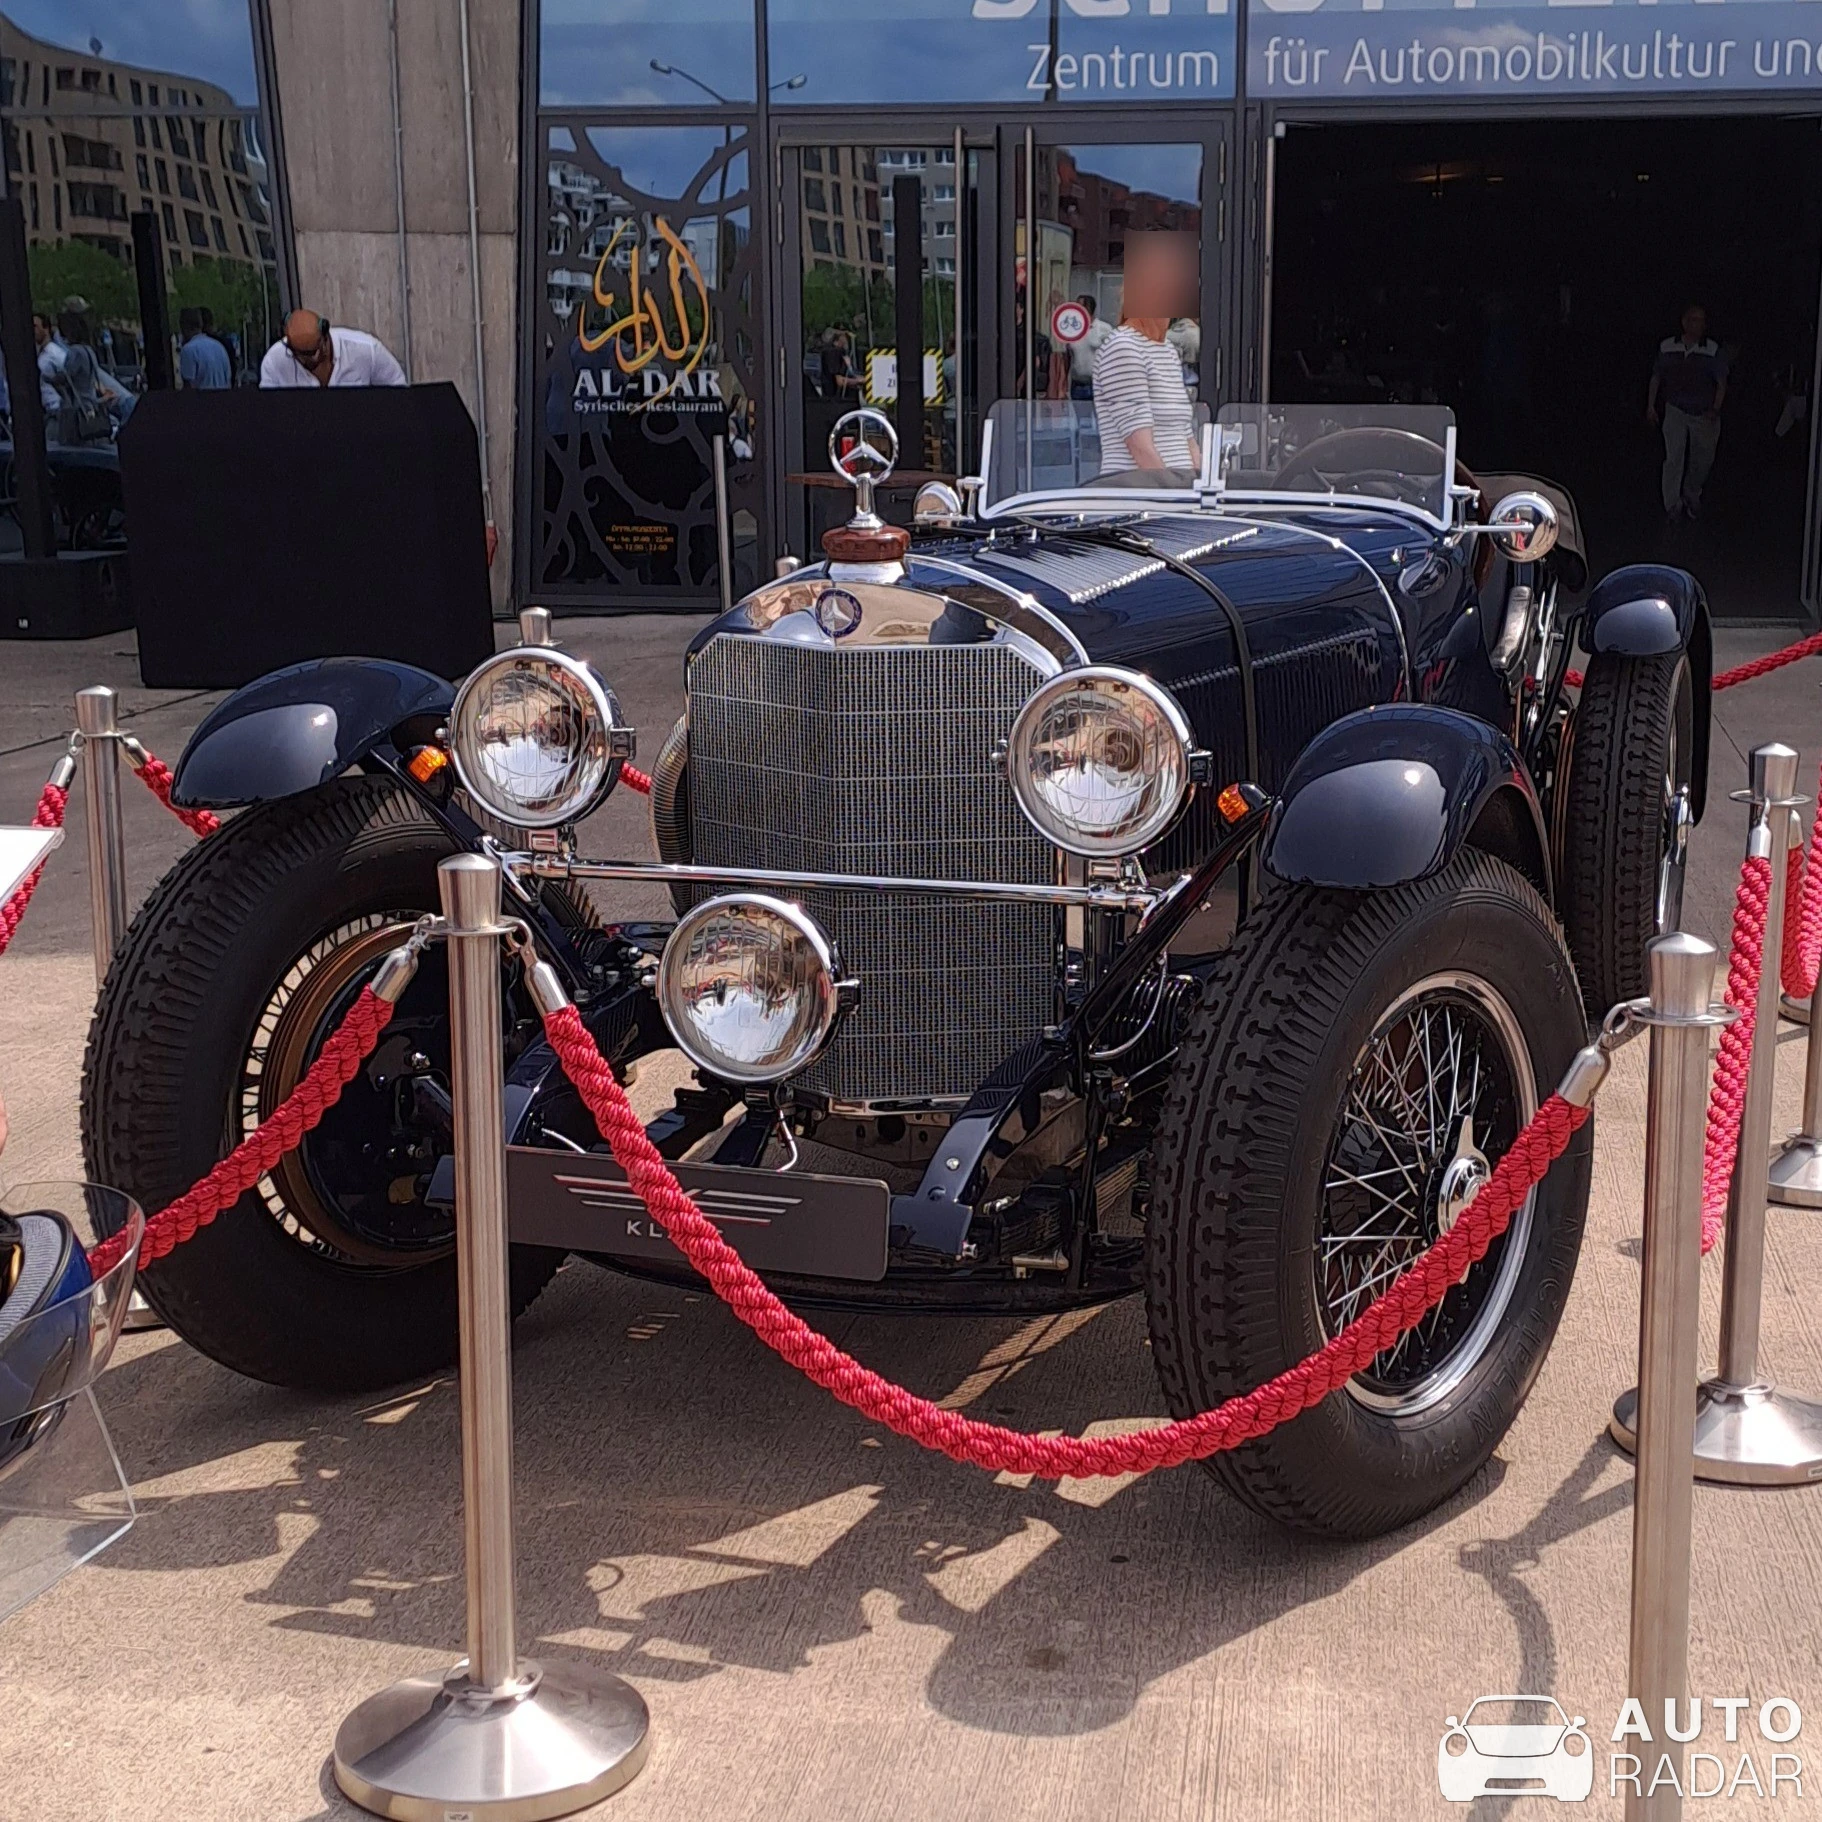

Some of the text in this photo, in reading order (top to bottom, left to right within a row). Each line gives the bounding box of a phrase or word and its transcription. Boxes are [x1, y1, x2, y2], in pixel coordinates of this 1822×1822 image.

[1026, 30, 1822, 90] Zentrum für Automobilkultur un
[572, 368, 723, 397] AL-DAR
[573, 399, 724, 413] Syrisches Restaurant
